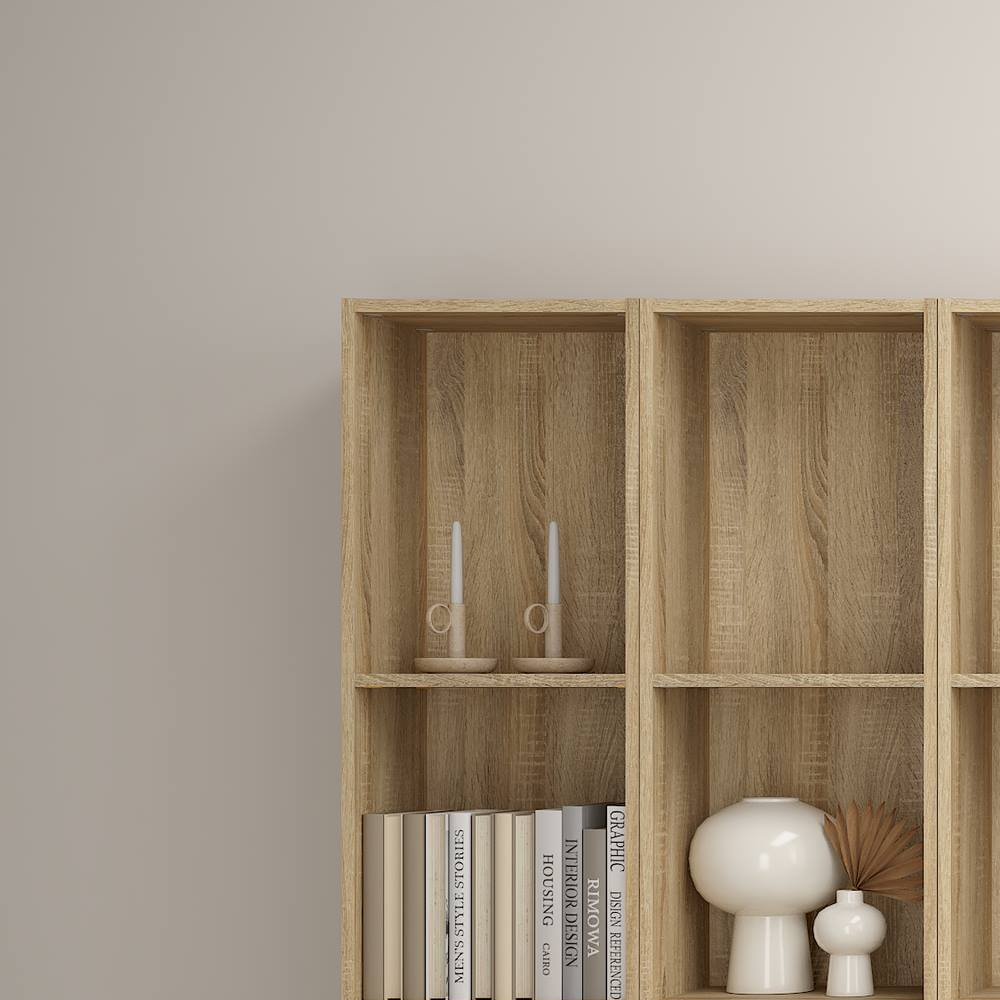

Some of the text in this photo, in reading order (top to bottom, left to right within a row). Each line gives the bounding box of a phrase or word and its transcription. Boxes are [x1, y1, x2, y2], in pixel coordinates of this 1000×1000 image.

[610, 810, 625, 872] GRAPHIC
[454, 829, 465, 984] MEN'S STYLE STORIES
[543, 854, 554, 927] HOUSING
[565, 839, 578, 968] INTERIOR DESIGN
[587, 878, 600, 958] RIMOWA
[610, 932, 622, 1000] REFERENCED
